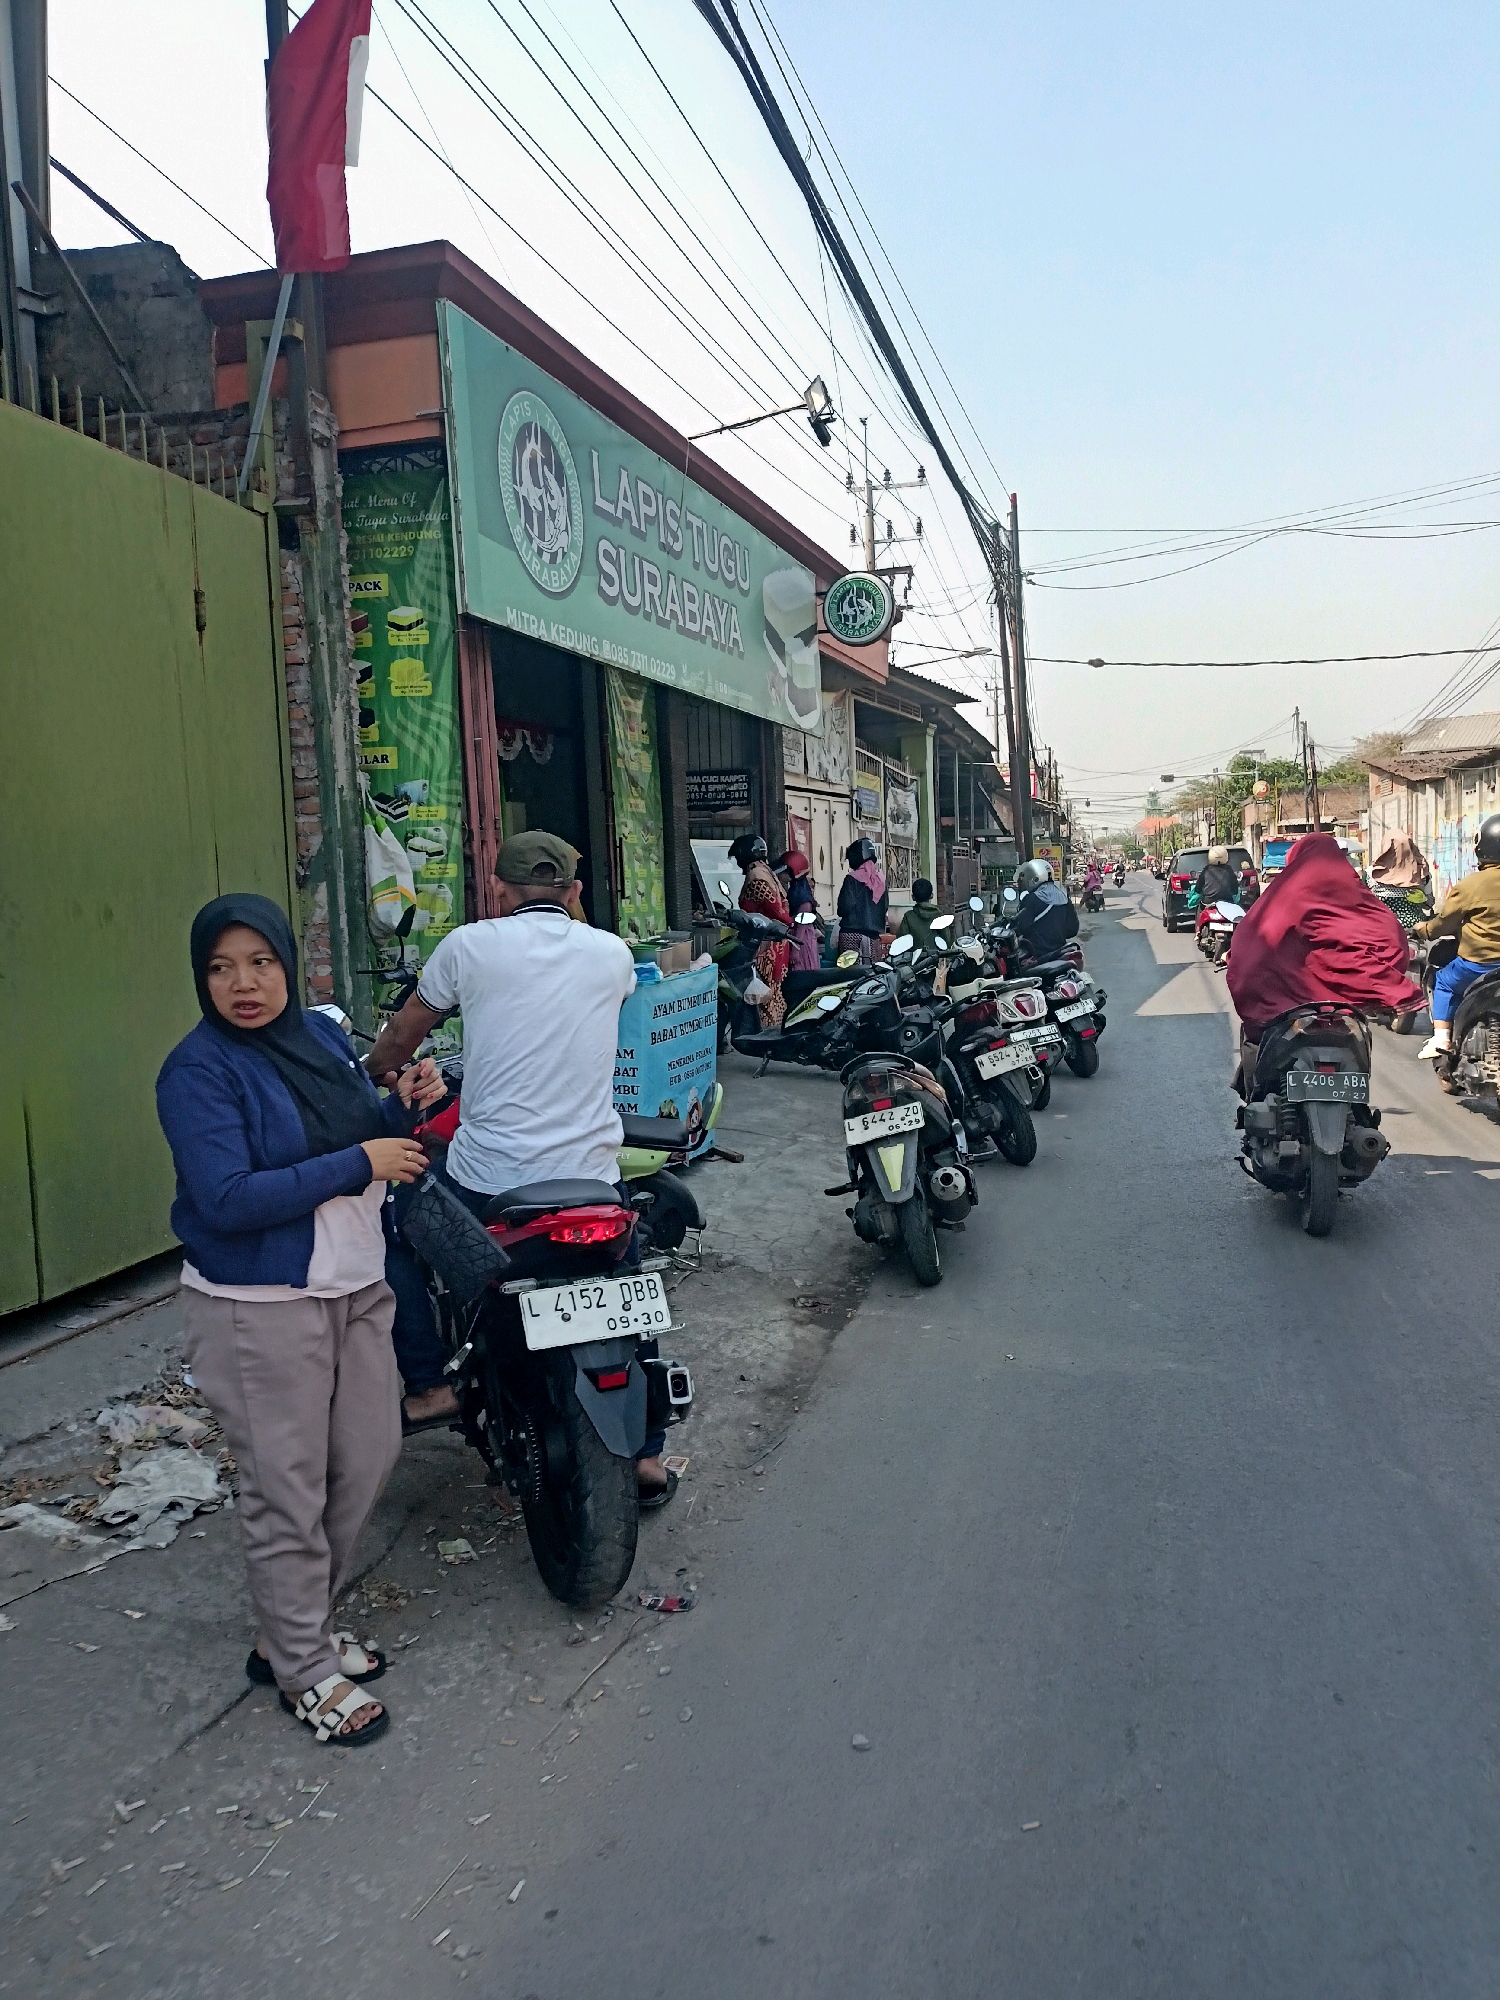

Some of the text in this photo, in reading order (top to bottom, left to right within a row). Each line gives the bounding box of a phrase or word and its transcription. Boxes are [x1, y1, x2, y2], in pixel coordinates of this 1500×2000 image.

[504, 401, 574, 476] LAPIS TUGU
[364, 494, 399, 508] Menu
[402, 491, 418, 508] Of
[356, 514, 387, 530] Tugu
[391, 510, 450, 525] Surabaya
[591, 448, 750, 592] LAPIS TUGU
[387, 529, 443, 542] KENDUNG
[513, 523, 579, 589] SURABAYA
[348, 580, 383, 592] PACK
[834, 581, 879, 603] LAPIS TUGU
[598, 538, 745, 654] SURABAYA
[836, 618, 880, 636] SURABAYA
[506, 606, 548, 639] MITRA
[550, 623, 600, 655] KEDUNG
[610, 645, 629, 666] 085
[630, 651, 648, 672] 7311
[650, 656, 676, 681] 02229
[686, 784, 699, 792] OFA
[702, 775, 719, 783] CUCI
[652, 989, 718, 1019] AYAM BUMBU HITA
[651, 1012, 718, 1046] BABAT BUMBU HITA
[615, 1048, 635, 1060] AM
[613, 1066, 639, 1078] BAT
[1288, 1073, 1367, 1088] L 4406 ABA
[612, 1084, 640, 1096] MBU
[612, 1102, 639, 1113] TAM
[847, 1121, 855, 1132] L
[861, 1111, 895, 1127] 6442
[527, 1277, 660, 1318] L 4152 DBB
